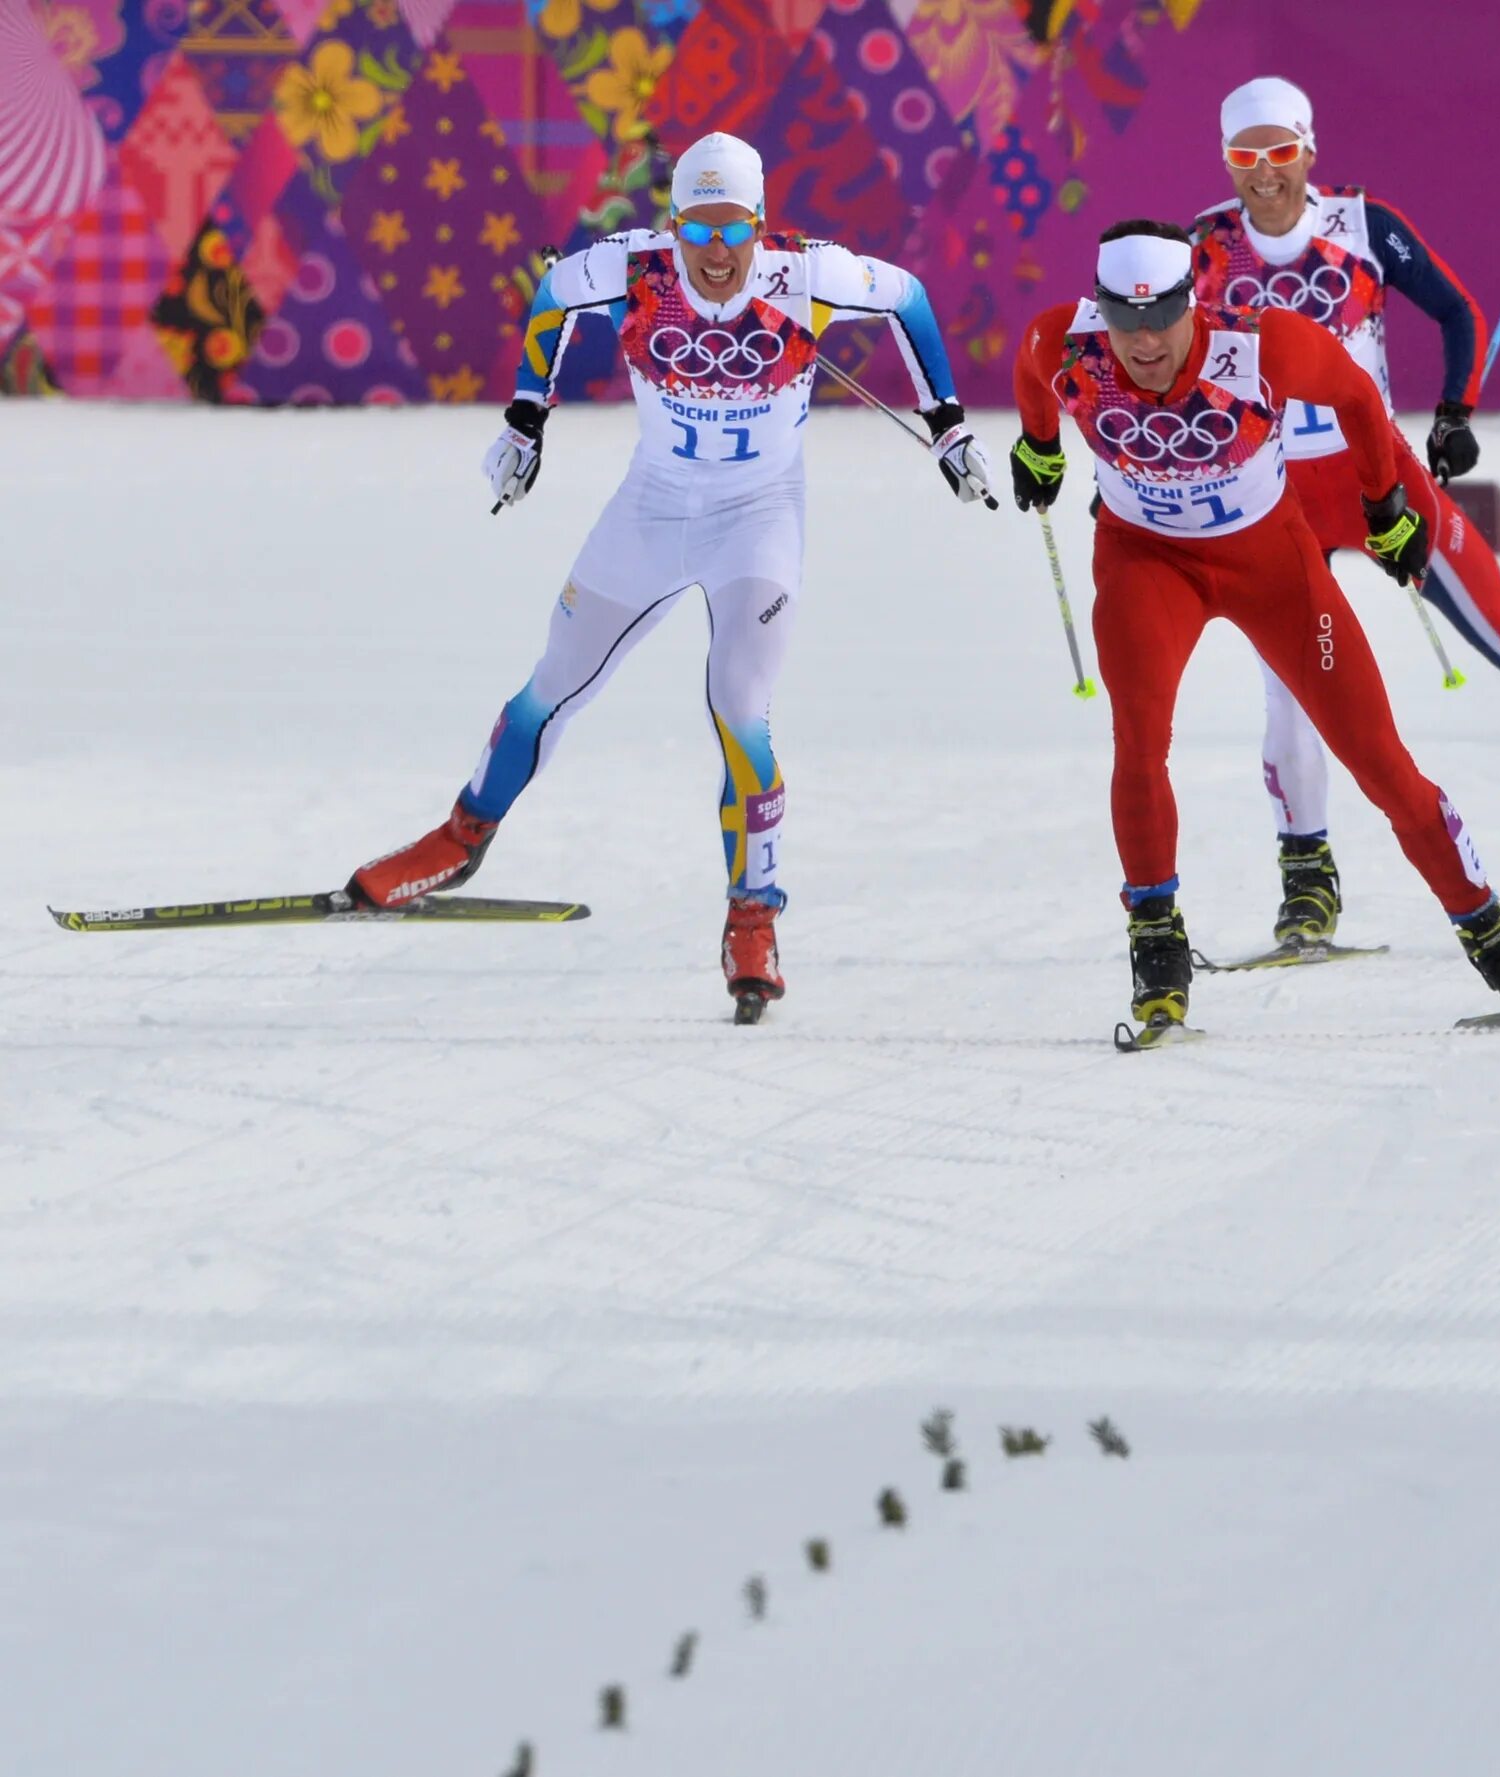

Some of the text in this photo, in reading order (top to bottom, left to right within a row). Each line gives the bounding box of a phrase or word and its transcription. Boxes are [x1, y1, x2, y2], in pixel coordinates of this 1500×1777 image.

[692, 188, 727, 197] SWE
[661, 396, 718, 422] SOCHI
[671, 417, 761, 462] 11
[1138, 493, 1244, 530] 21
[1317, 613, 1334, 671] odlo
